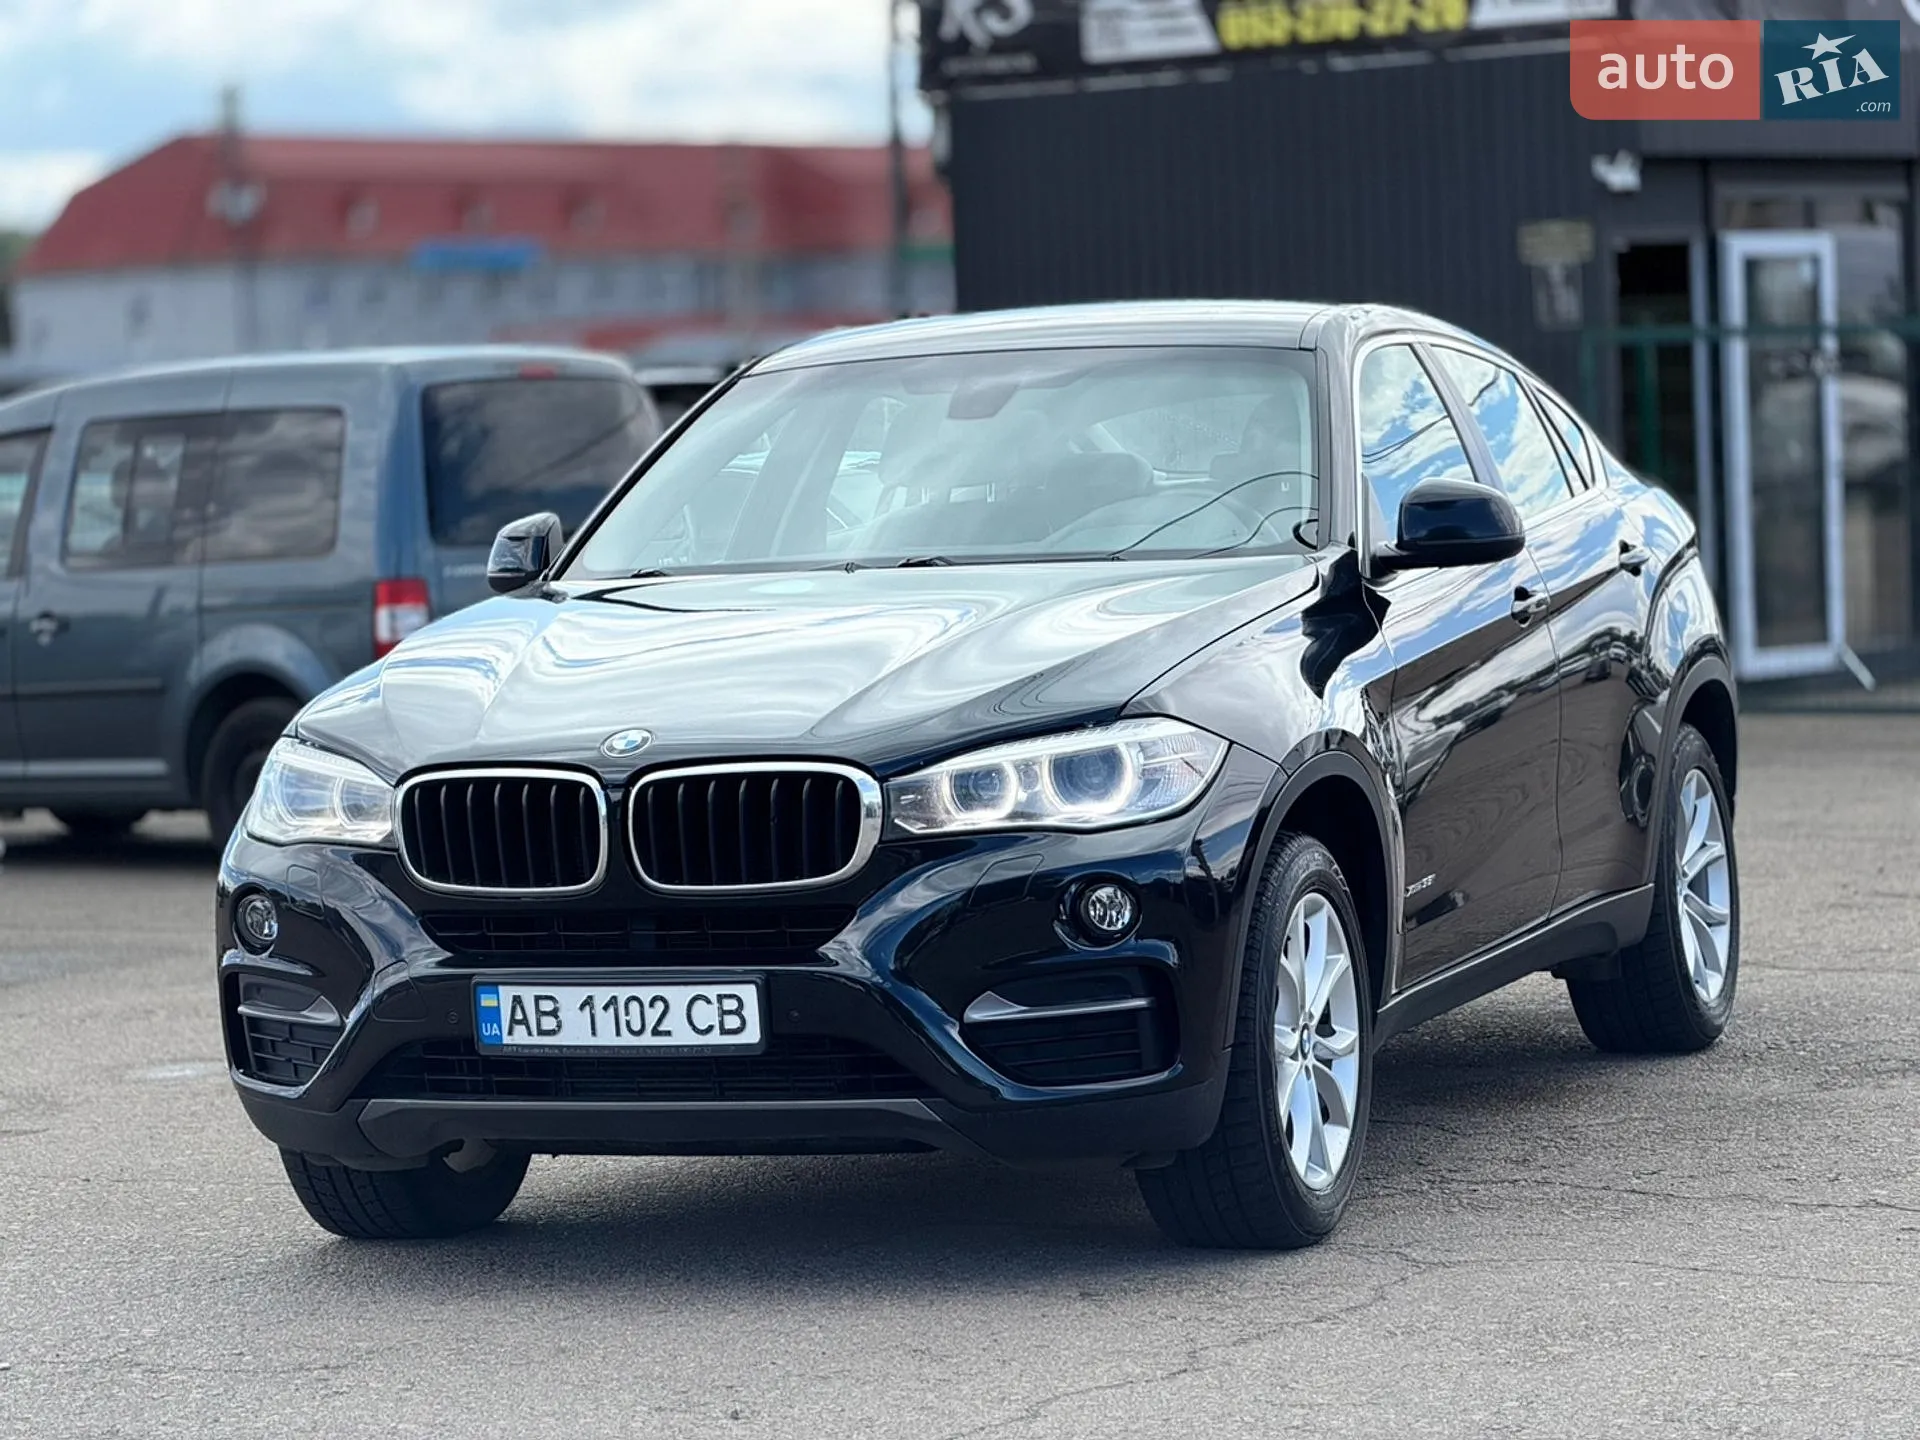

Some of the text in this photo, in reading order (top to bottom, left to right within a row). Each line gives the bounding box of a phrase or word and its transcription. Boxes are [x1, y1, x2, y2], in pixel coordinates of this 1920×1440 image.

[507, 993, 746, 1037] AB 1102 CB
[482, 1023, 500, 1036] UA
